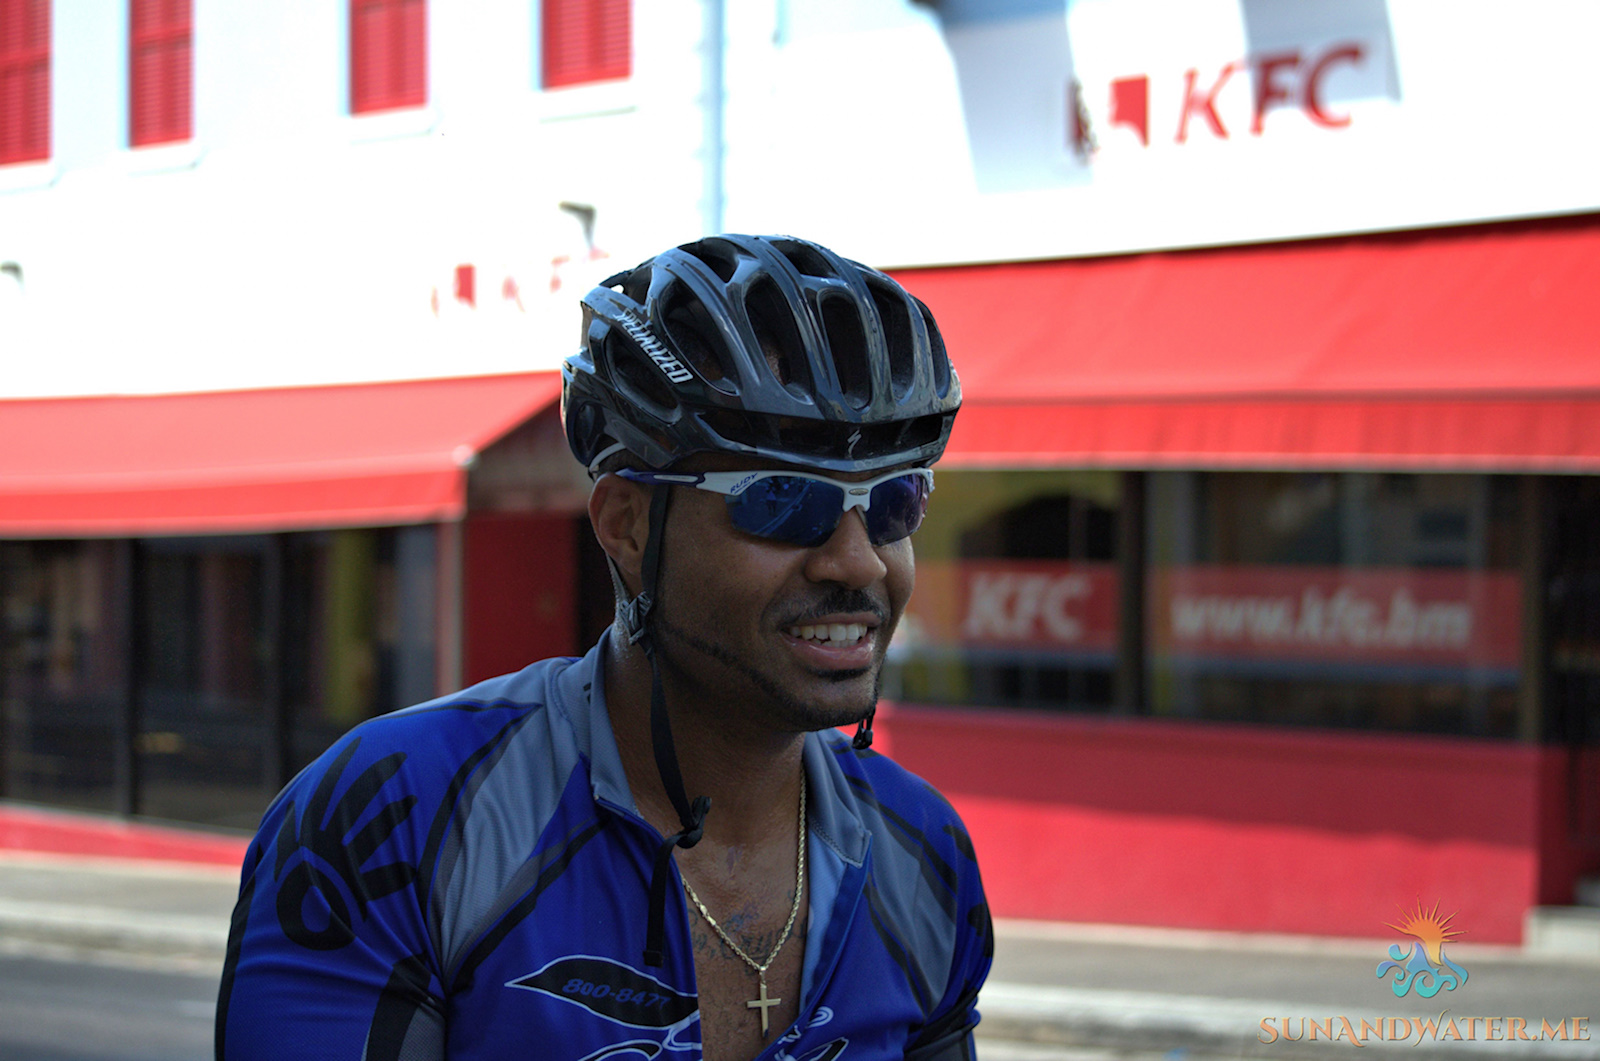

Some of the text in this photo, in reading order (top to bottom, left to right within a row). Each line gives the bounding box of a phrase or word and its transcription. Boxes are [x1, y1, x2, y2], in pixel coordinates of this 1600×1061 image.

[1174, 42, 1366, 145] KFC
[612, 307, 694, 384] SPECIALIZED
[730, 472, 758, 494] RUDY
[964, 572, 1091, 640] KFC
[1169, 584, 1474, 648] www.kfc.bm
